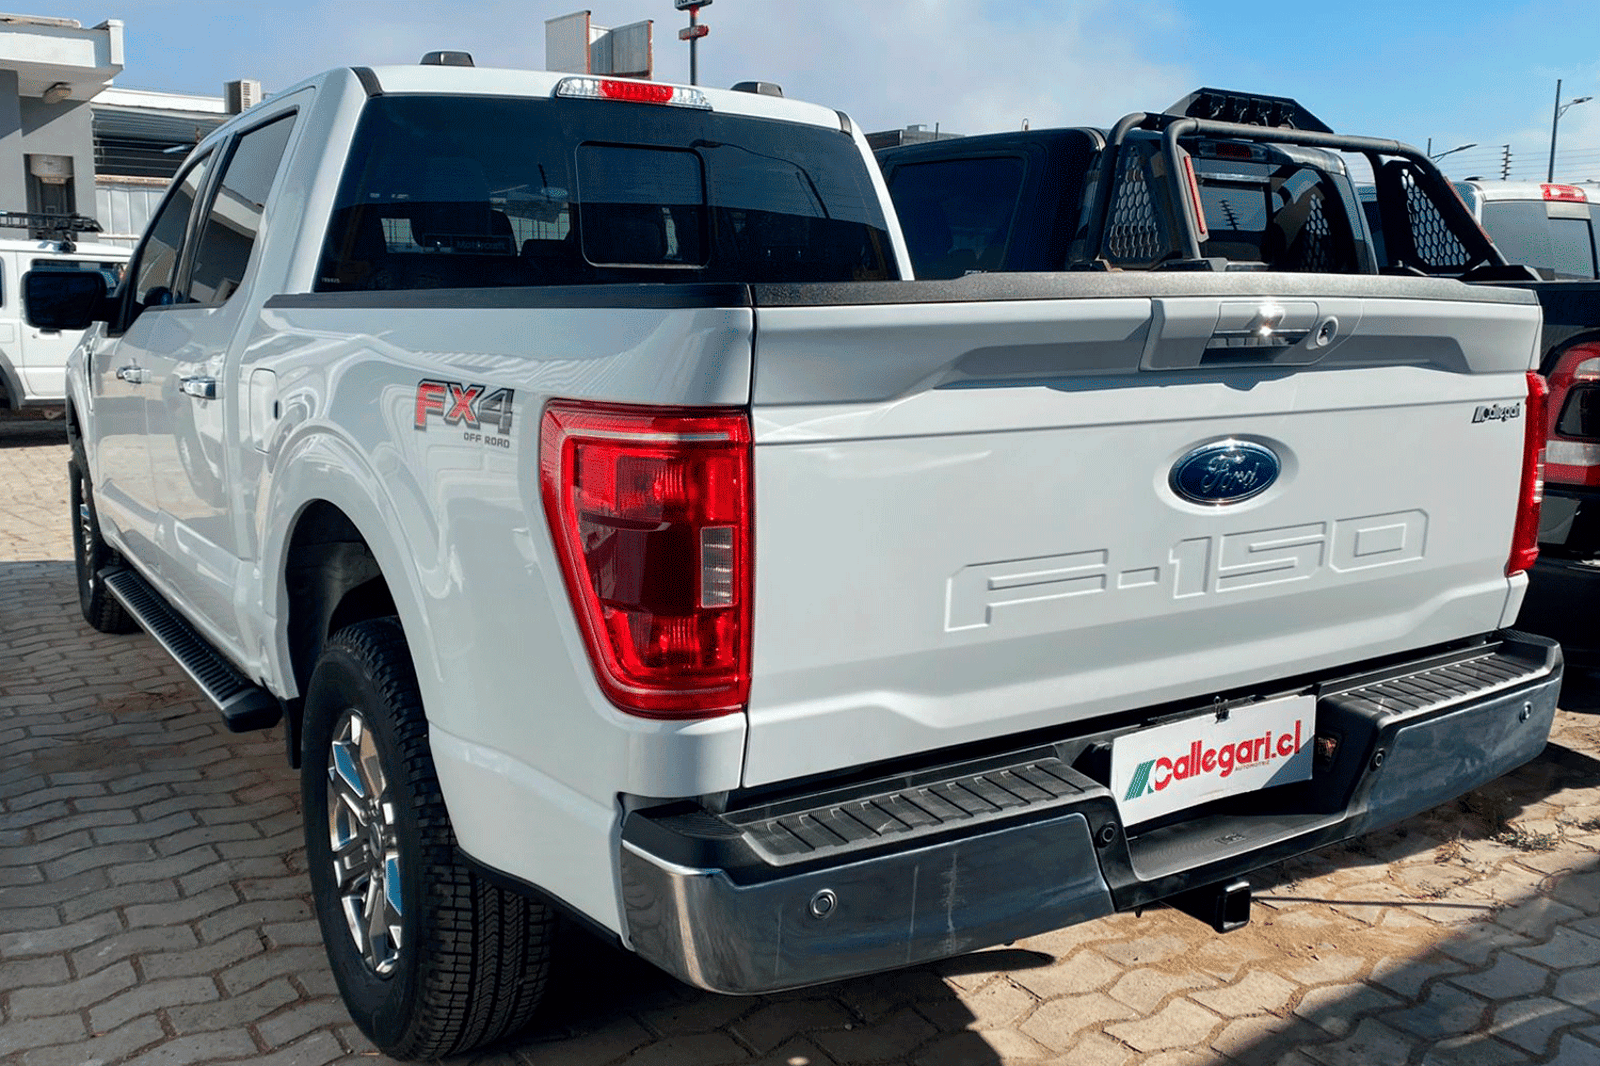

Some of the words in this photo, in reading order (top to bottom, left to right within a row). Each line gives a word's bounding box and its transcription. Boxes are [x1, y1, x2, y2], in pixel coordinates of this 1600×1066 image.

[414, 378, 515, 434] FX4
[463, 432, 482, 442] OFF
[484, 435, 511, 449] ROAD
[1201, 455, 1259, 493] Ford
[944, 508, 1429, 632] F-150
[1154, 719, 1302, 792] Callegari.cl
